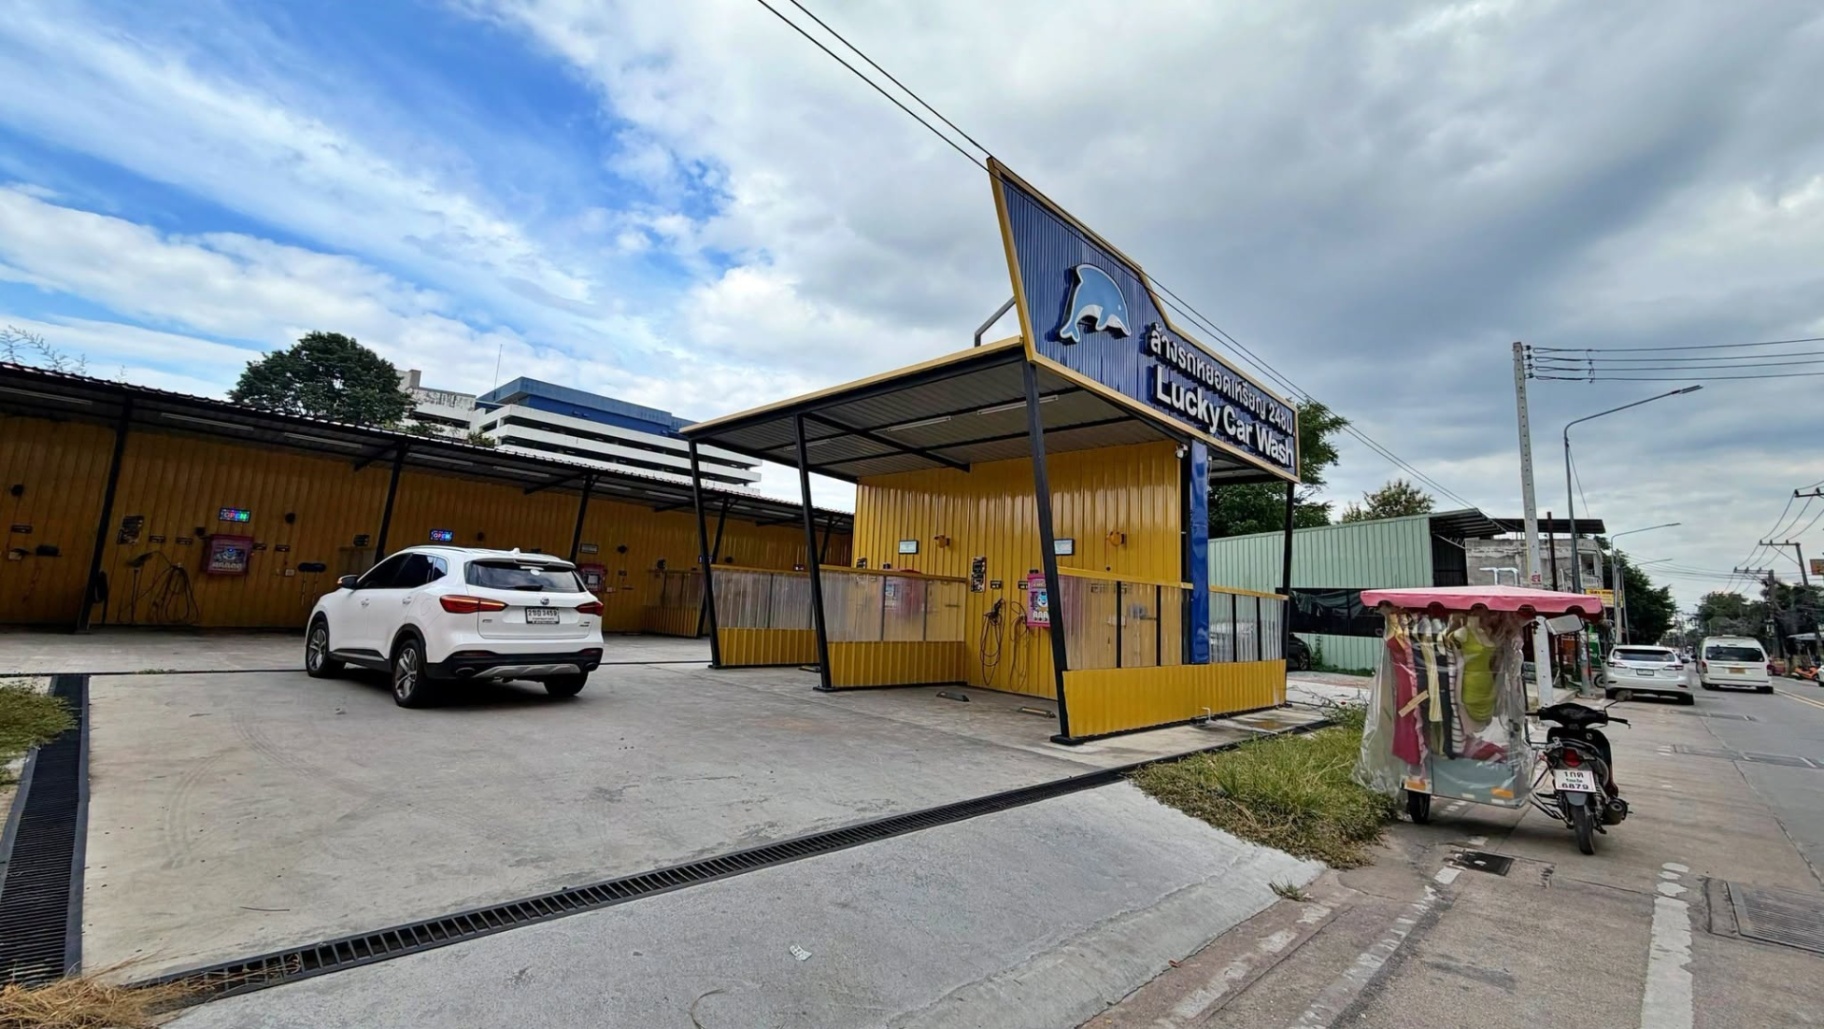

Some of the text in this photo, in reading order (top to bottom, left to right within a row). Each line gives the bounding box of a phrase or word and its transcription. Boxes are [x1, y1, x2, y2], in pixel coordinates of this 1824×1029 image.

[1157, 365, 1294, 467] Lucky Car Wash
